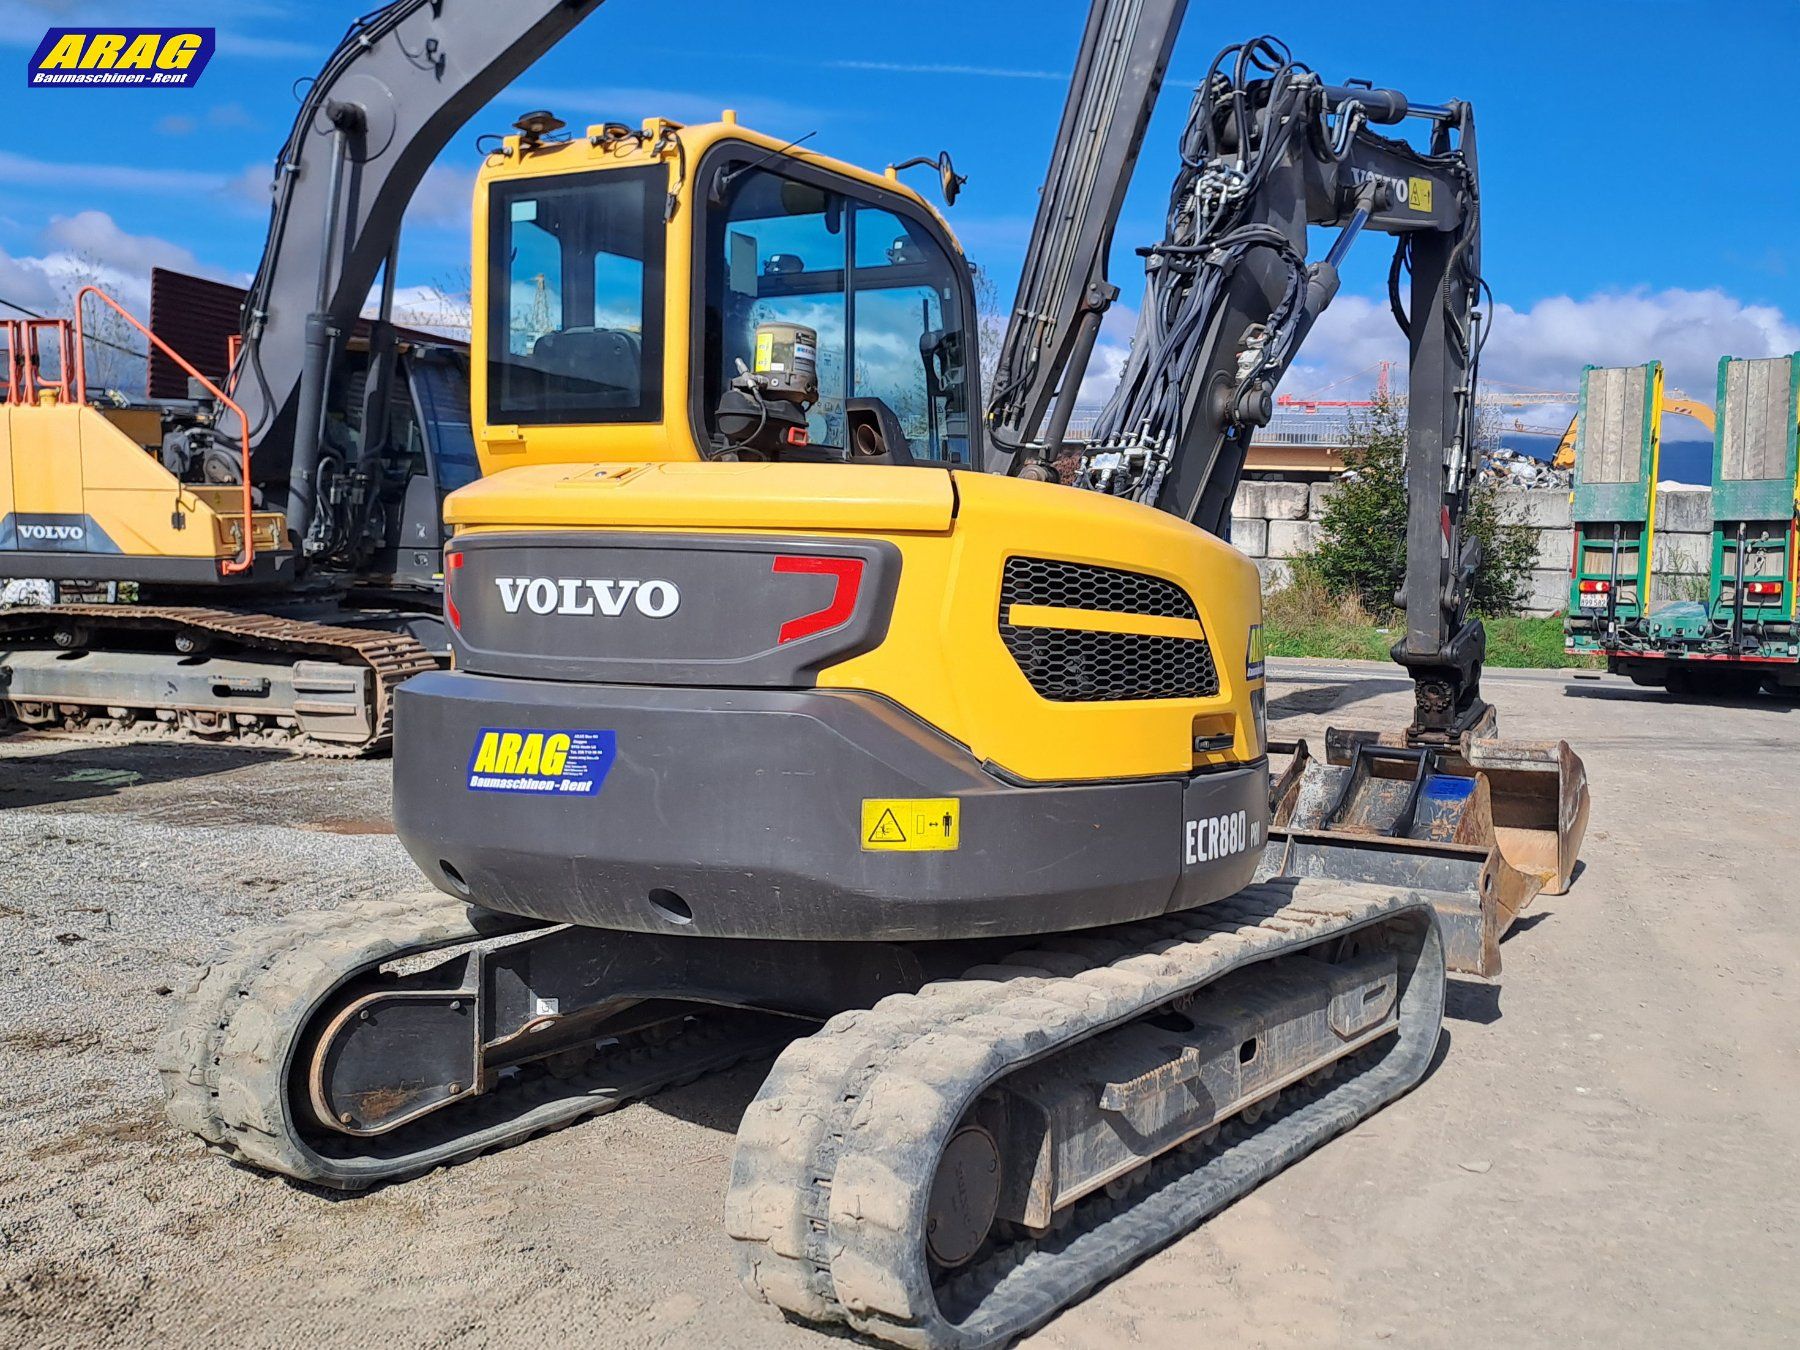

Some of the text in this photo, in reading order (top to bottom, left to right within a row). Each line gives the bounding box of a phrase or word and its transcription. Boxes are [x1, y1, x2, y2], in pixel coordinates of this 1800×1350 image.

[17, 526, 83, 540] VOLVO
[494, 577, 681, 619] VOLVO
[473, 732, 571, 776] ARAG
[469, 775, 593, 792] Baumaschinen-Rent
[1185, 809, 1246, 865] ECR88D
